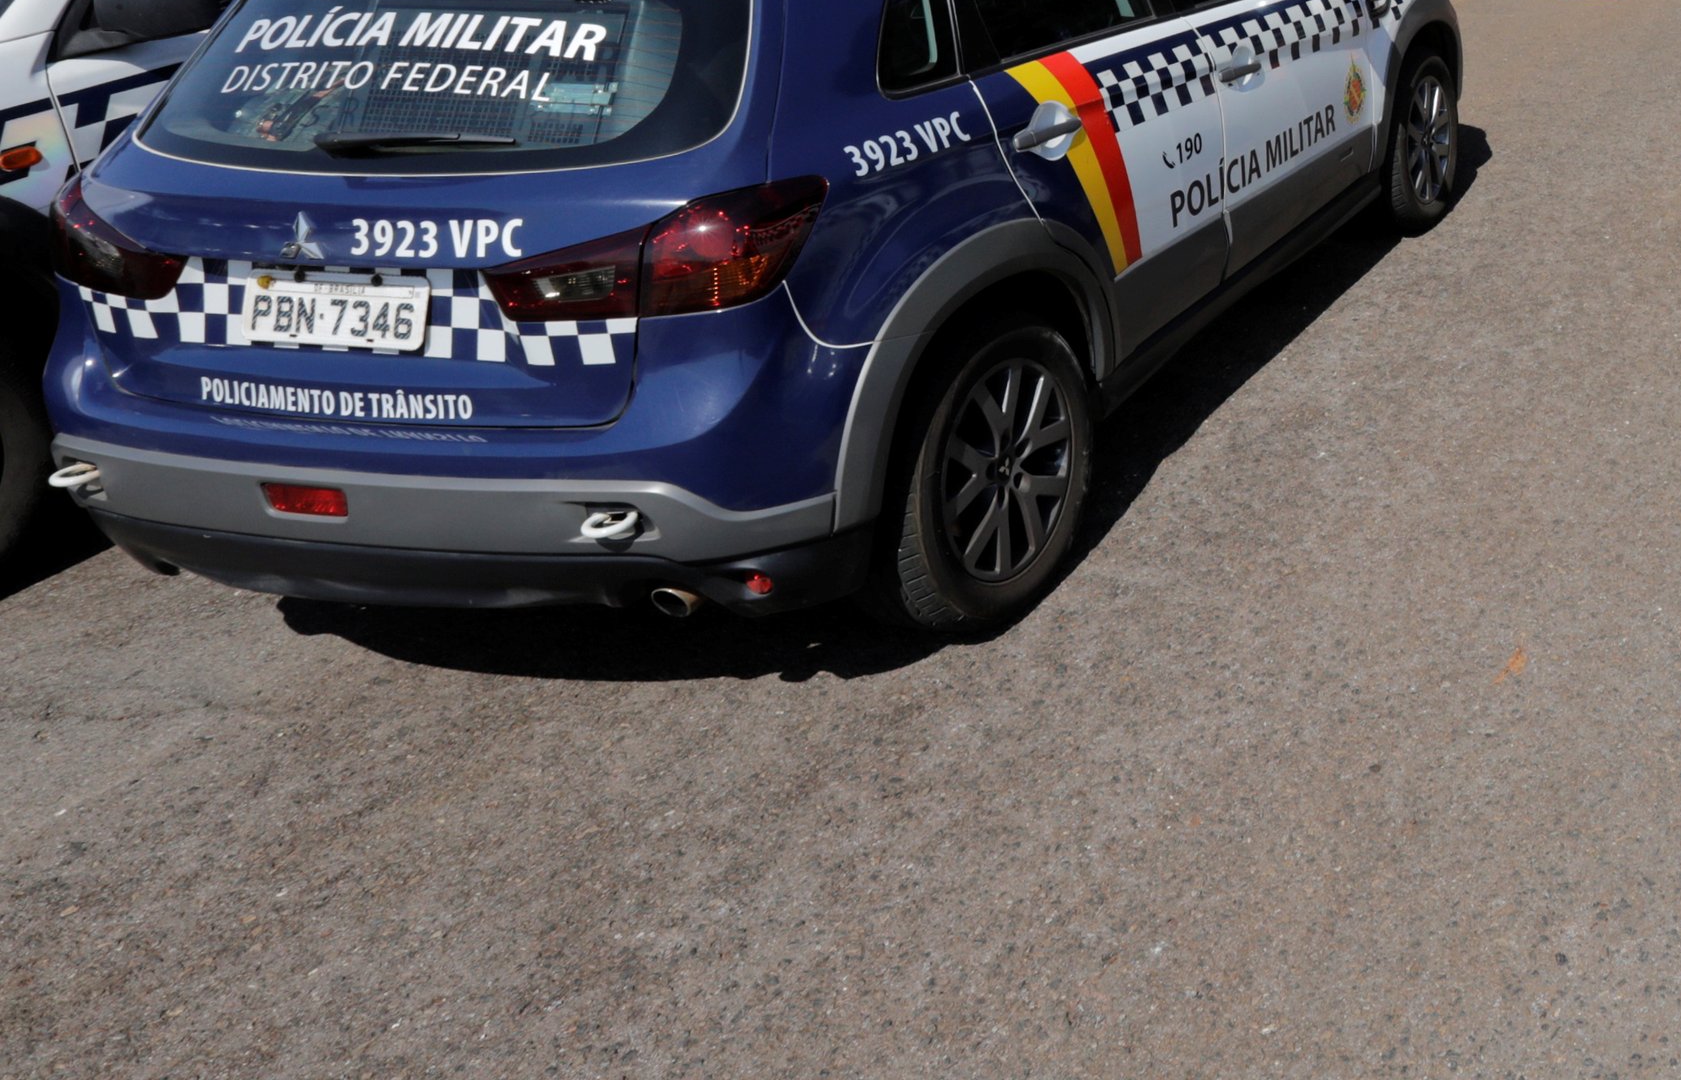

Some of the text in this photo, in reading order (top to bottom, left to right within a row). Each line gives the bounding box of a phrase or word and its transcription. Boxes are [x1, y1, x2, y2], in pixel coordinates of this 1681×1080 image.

[235, 5, 607, 61] POLÍCIA MILITAR
[220, 60, 551, 102] DISTRITO FEDERAL
[843, 111, 971, 177] 3923 VPC
[1170, 104, 1336, 228] POLÍCIA MILITAR
[1176, 133, 1202, 164] 190
[350, 218, 524, 258] 3923 VPC
[200, 376, 473, 420] POLICIAMENTO DE TRÂNSITO
